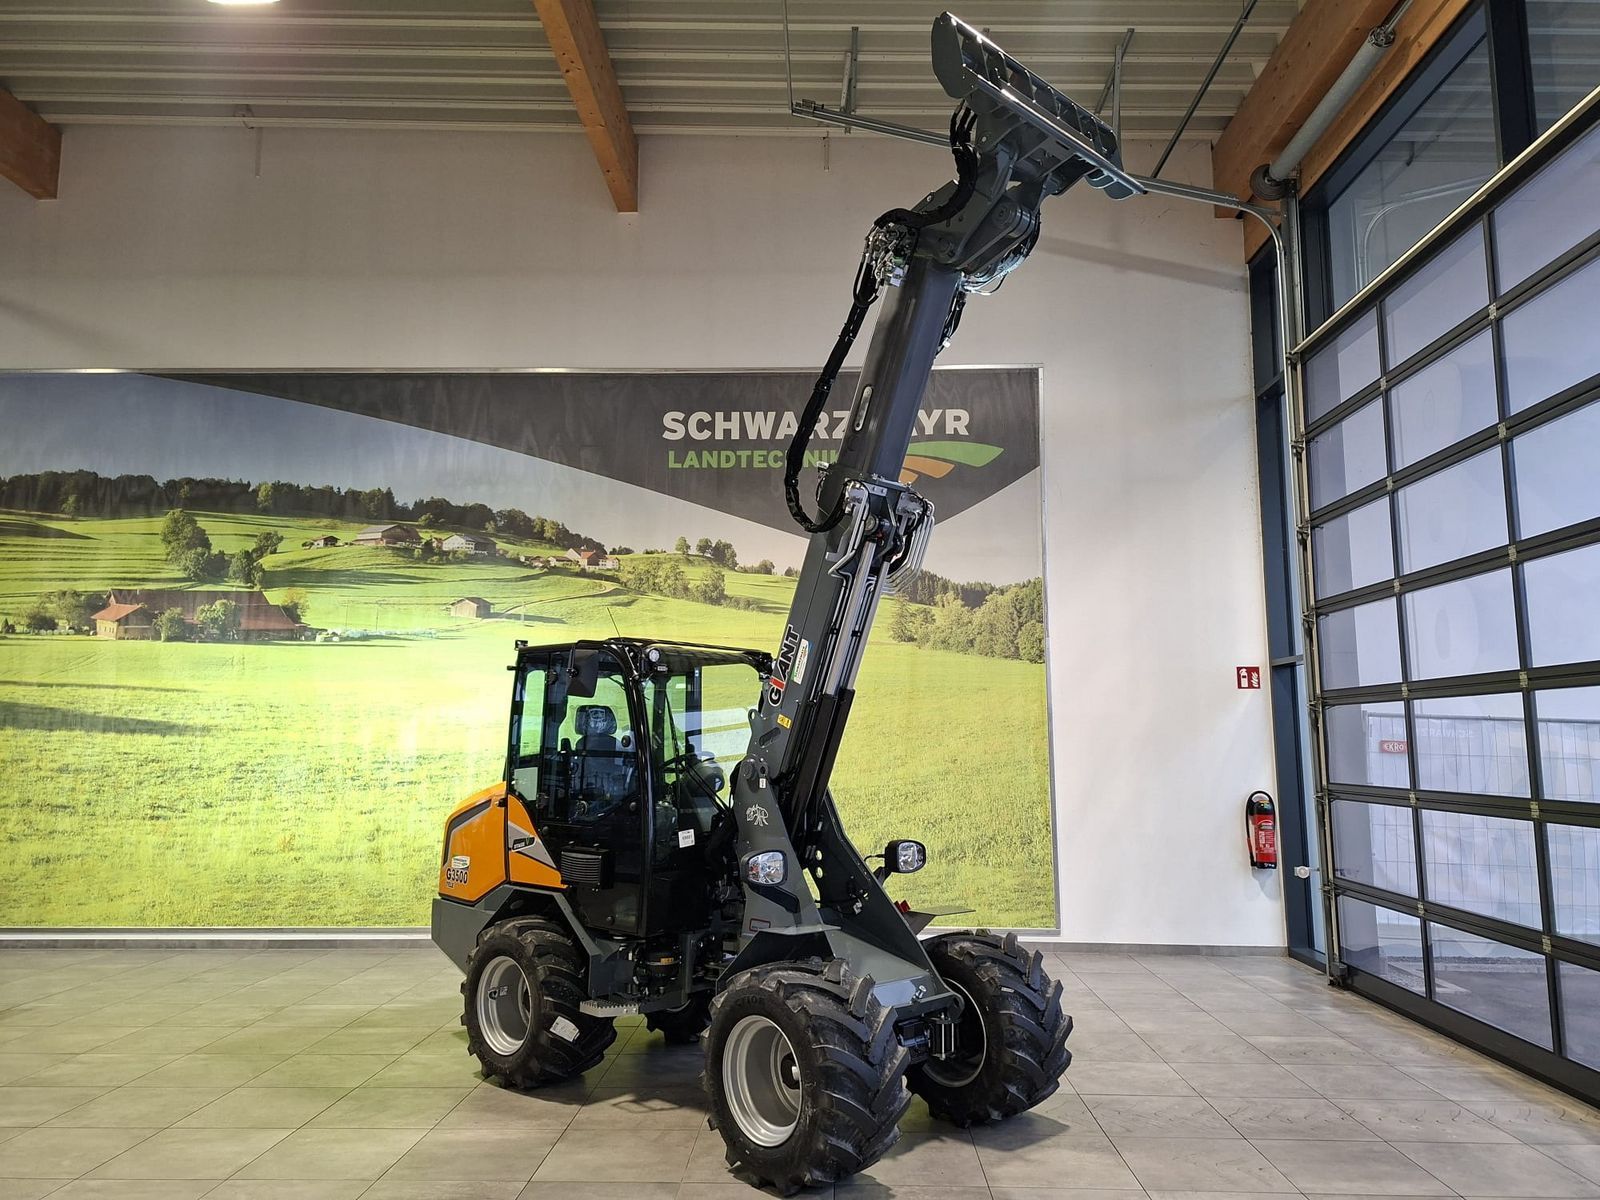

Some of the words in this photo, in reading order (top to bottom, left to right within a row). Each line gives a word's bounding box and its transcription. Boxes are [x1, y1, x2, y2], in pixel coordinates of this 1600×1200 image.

[662, 409, 970, 441] SCHWARZYR
[668, 450, 840, 469] LANDTECNIK
[768, 624, 799, 706] GIANT
[446, 868, 468, 884] G3500
